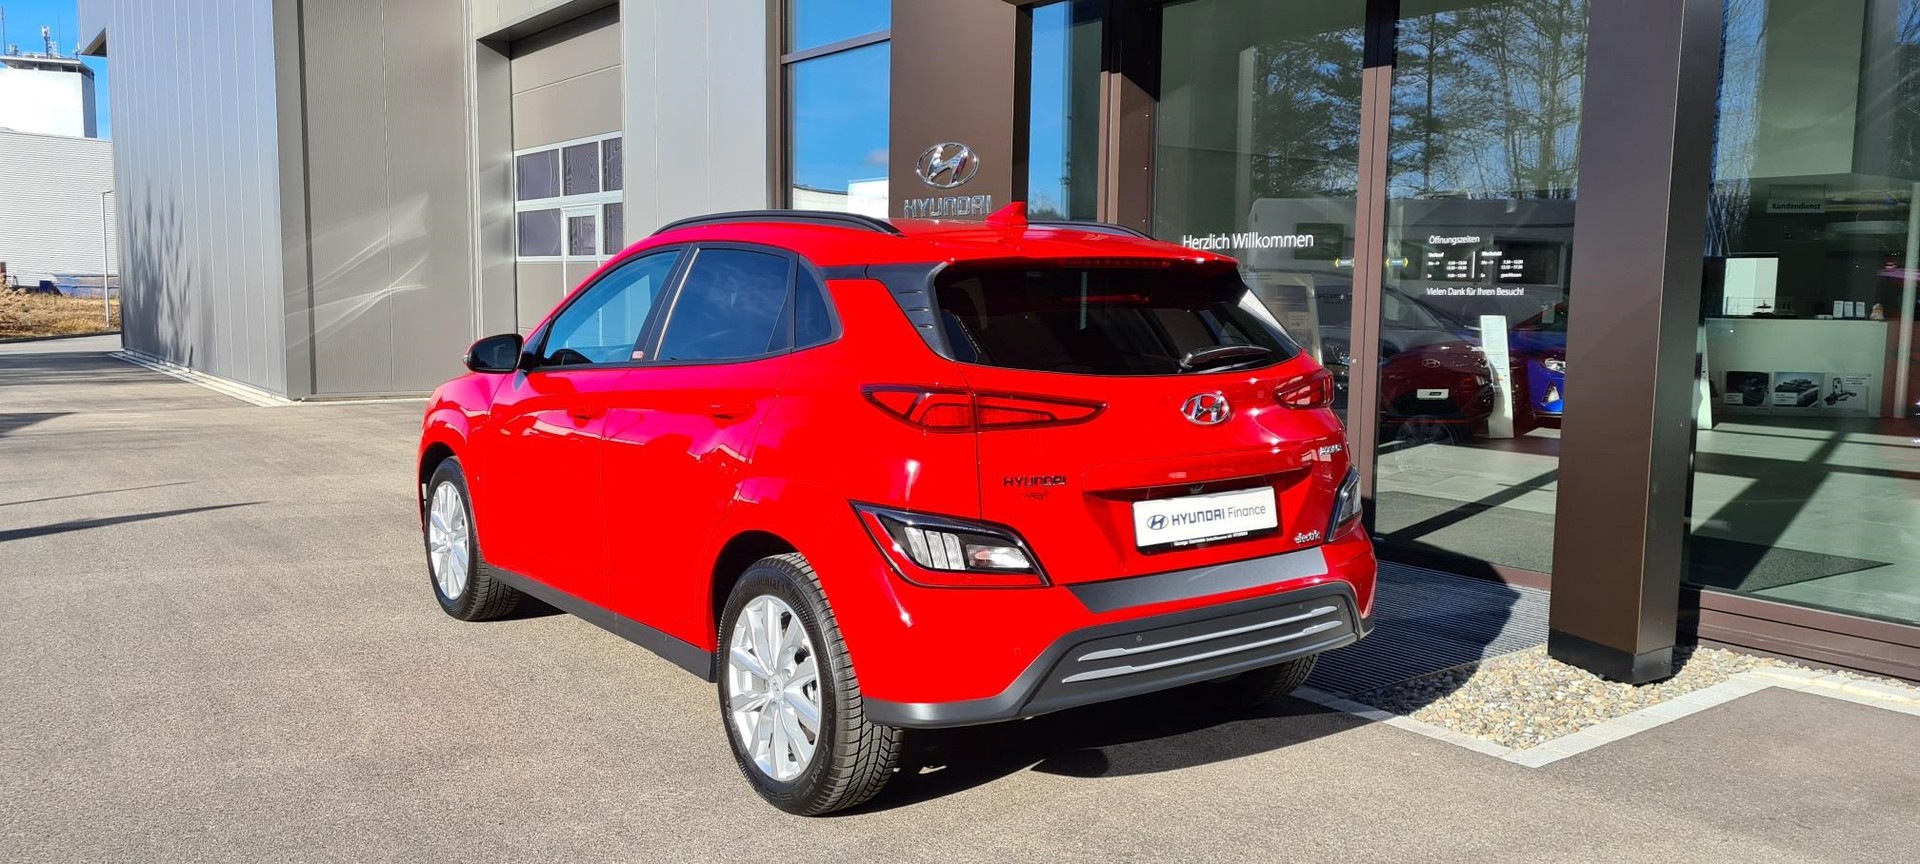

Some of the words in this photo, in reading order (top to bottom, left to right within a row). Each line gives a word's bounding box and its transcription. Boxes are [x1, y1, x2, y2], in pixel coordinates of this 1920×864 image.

[904, 195, 992, 218] HYUNDAI
[1183, 233, 1230, 250] Herzlich
[1232, 232, 1314, 248] Willkommen
[1428, 234, 1480, 245] Öffnungszeiten
[1427, 287, 1446, 296] Vielen
[1448, 287, 1465, 296] Dank
[1466, 287, 1476, 296] für
[1477, 287, 1494, 296] Ihren
[1496, 287, 1524, 296] Besuch!
[1003, 475, 1066, 486] HYUNDAI
[1171, 508, 1226, 526] HYUNDAI
[1227, 505, 1267, 518] Finance
